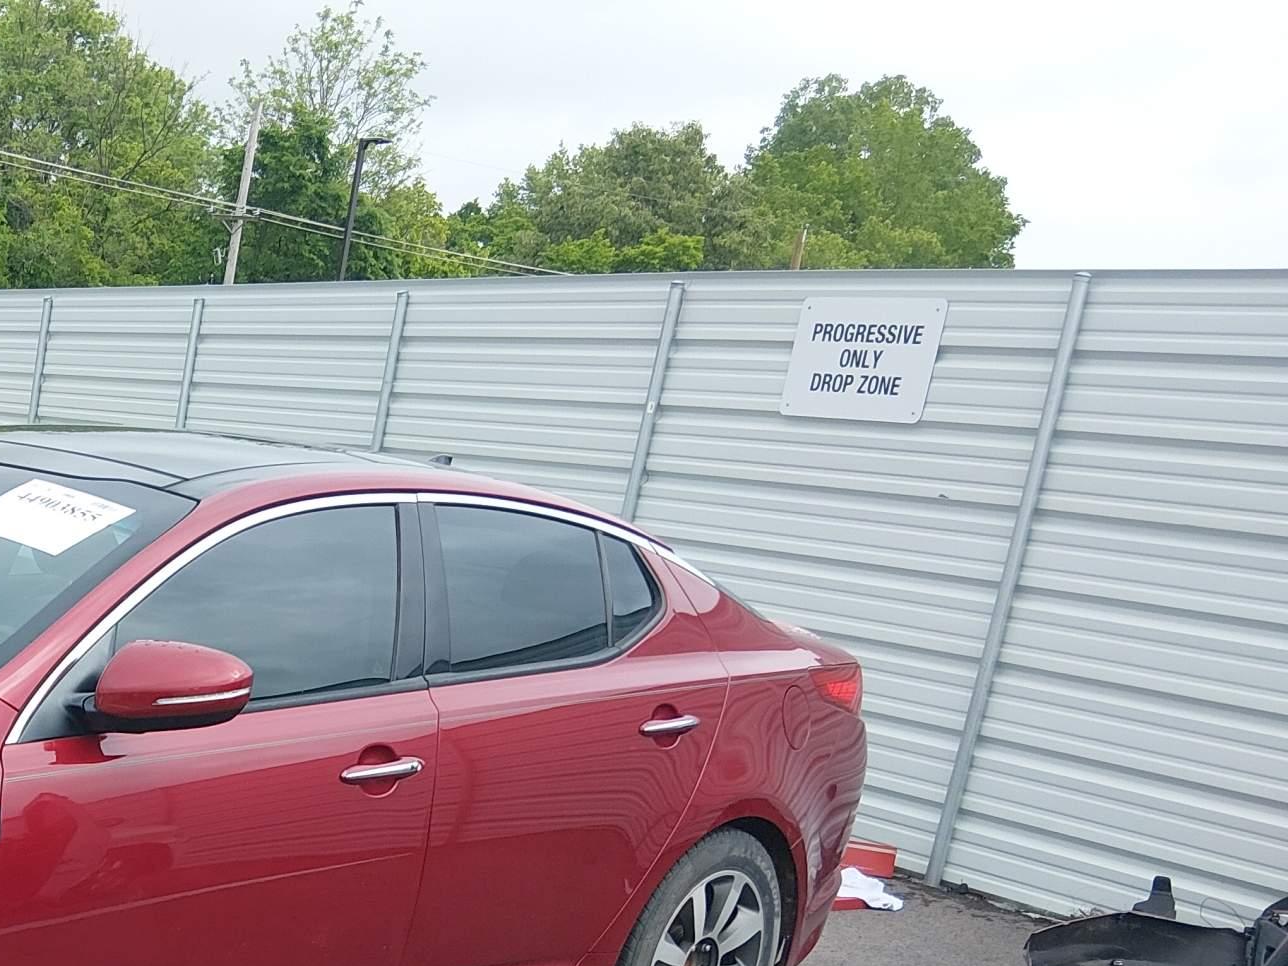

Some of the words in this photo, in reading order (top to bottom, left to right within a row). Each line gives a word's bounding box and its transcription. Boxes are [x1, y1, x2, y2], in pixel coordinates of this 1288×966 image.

[811, 323, 924, 345] PROGRESSIVE
[839, 349, 884, 369] ONLY
[809, 373, 854, 393] DROP
[856, 375, 902, 395] ZONE
